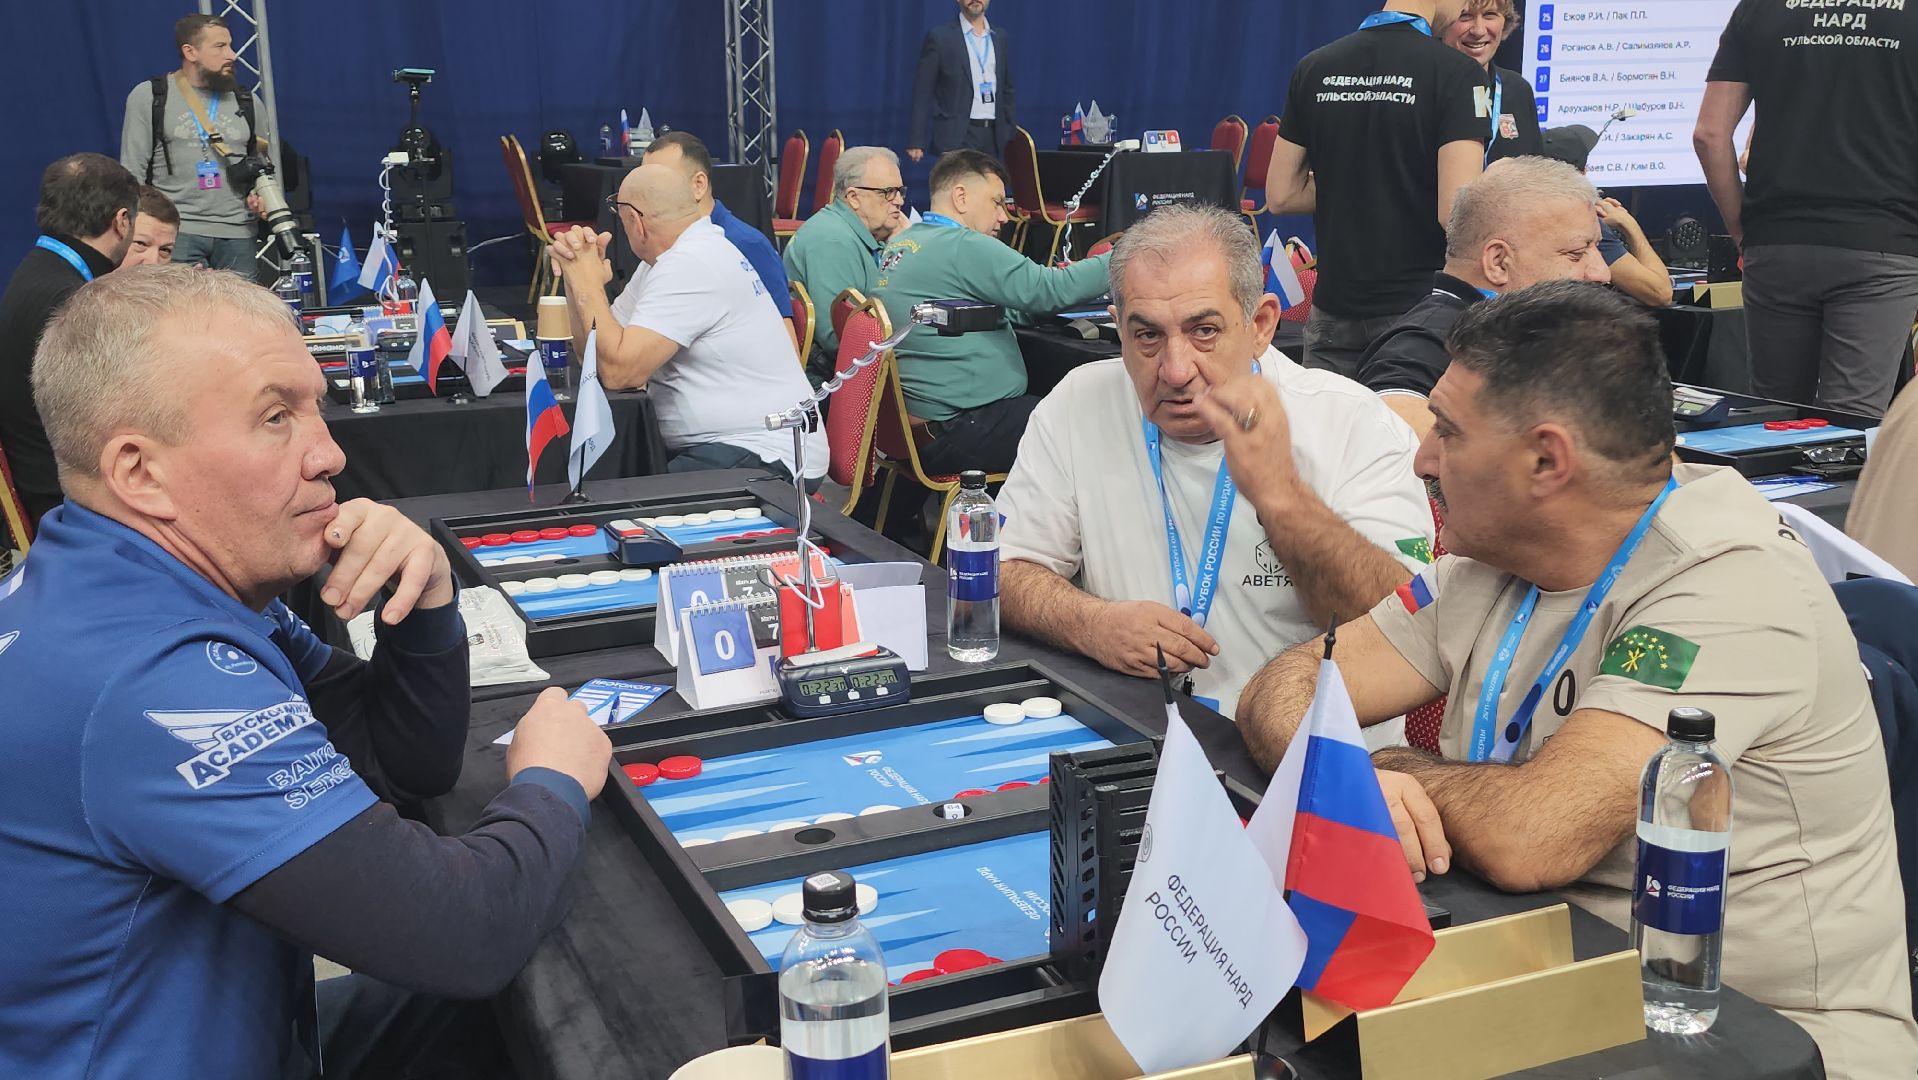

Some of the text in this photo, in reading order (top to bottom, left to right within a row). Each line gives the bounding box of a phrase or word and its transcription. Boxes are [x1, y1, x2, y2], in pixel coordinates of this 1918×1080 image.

[1563, 12, 1586, 21] Ежов
[1612, 11, 1628, 20] Пак
[1630, 10, 1648, 19] П.П.
[1813, 13, 1867, 30] НАРД
[1561, 43, 1596, 52] Роганов
[1598, 42, 1614, 51] А.В.
[1675, 40, 1691, 49] А.Р.
[1783, 34, 1900, 49] ТУЛЬСКОЙ ОБЛАСТИ
[1383, 75, 1413, 88] НАРД
[1560, 73, 1590, 82] Биянов
[1593, 73, 1608, 82] В.А.
[1660, 70, 1677, 80] В.Н.
[1316, 91, 1372, 103] ТУЛЬСКОЙ
[1621, 132, 1655, 142] Закарян
[1586, 163, 1604, 172] баев
[1631, 162, 1647, 171] Ким
[1197, 476, 1233, 610] КУБОК РОССИИ ПО НАРДАМ
[768, 622, 780, 640] 7
[714, 629, 735, 660] 0
[220, 702, 310, 741] BACKGMM
[190, 711, 309, 786] ACADEMY
[1145, 891, 1198, 964] РОССИИ
[1167, 874, 1254, 1010] ФЕДЕРАЦИЯ НАРД
